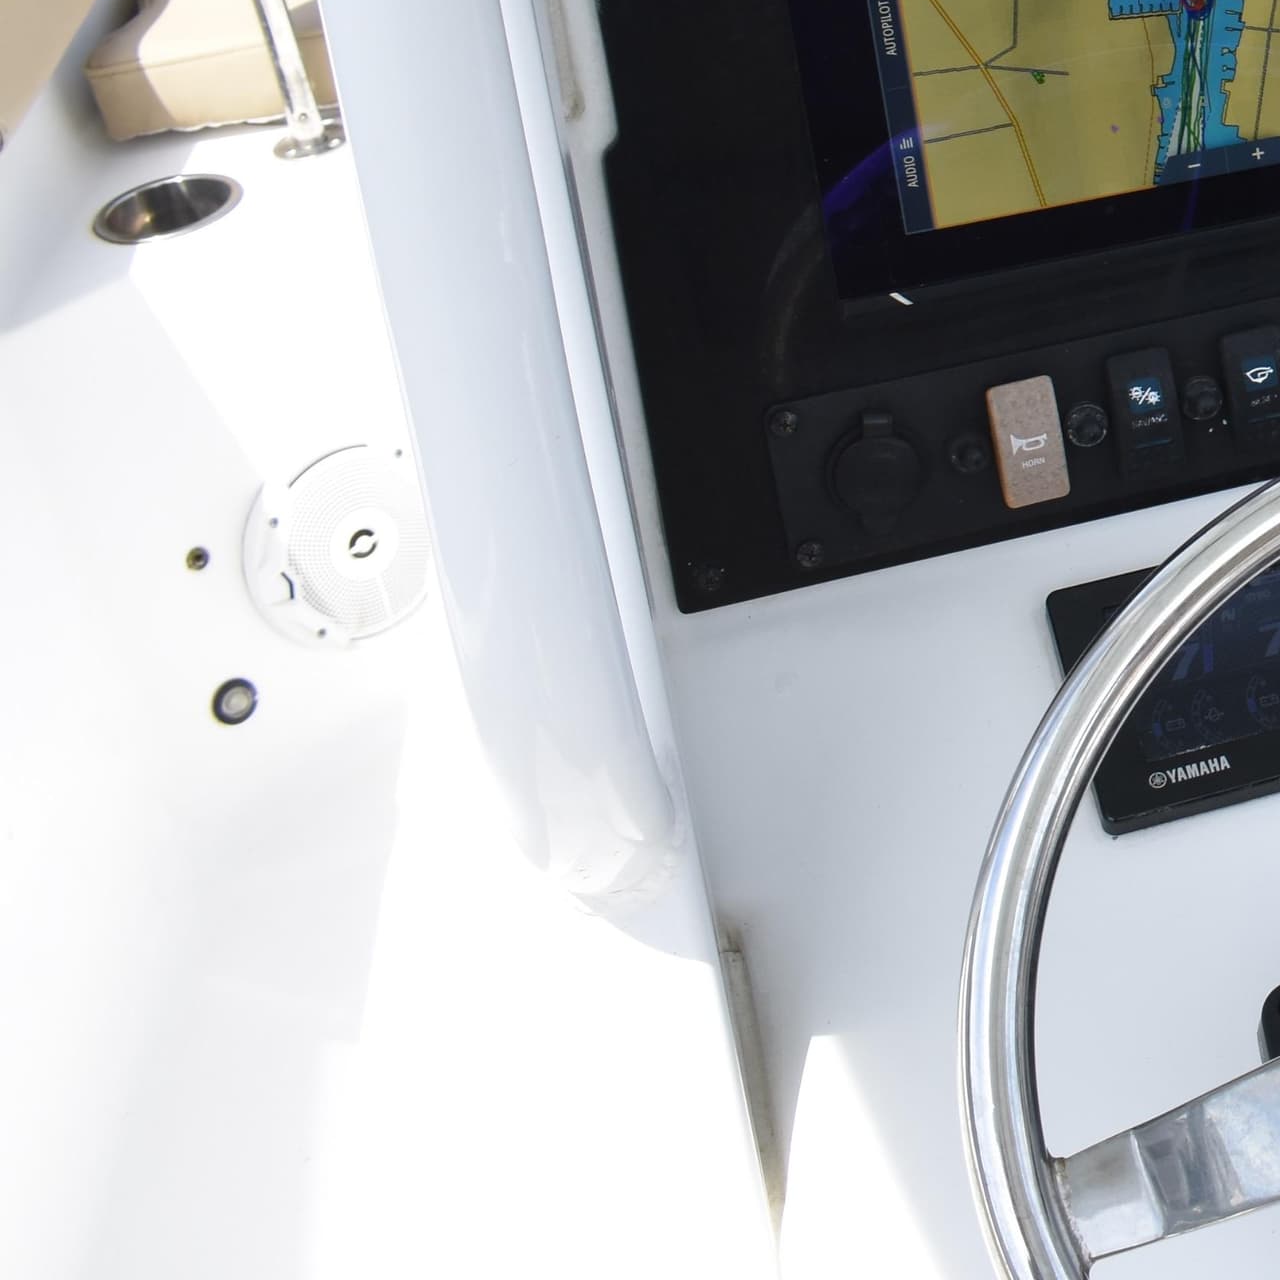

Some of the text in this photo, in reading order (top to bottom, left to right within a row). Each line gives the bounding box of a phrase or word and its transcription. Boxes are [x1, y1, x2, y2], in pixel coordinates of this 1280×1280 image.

[877, 0, 897, 56] AUTOPILOT
[903, 155, 919, 188] AUDIO
[1022, 457, 1045, 469] HORN
[1166, 755, 1231, 784] YAMAHA
